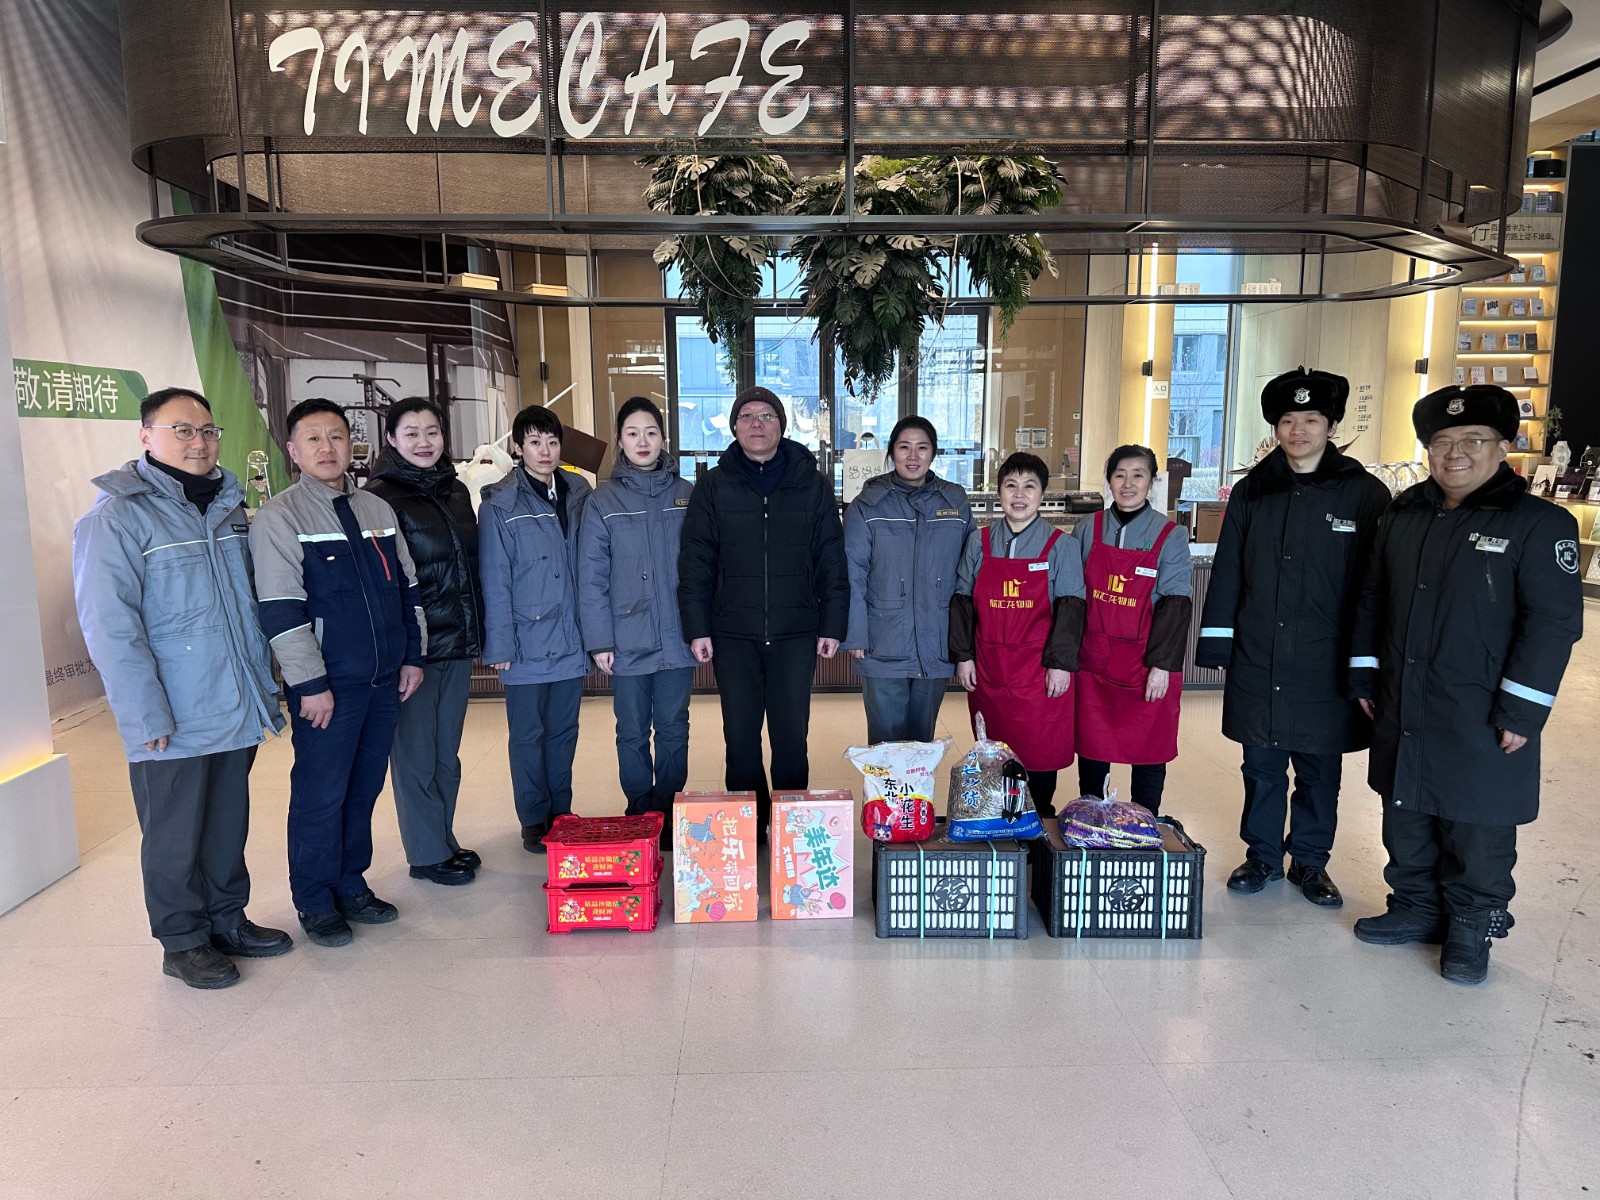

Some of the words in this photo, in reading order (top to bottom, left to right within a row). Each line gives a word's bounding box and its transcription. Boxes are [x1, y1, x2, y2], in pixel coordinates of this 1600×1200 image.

[13, 366, 119, 414] 敬请期待
[899, 782, 915, 831] 小花生
[720, 816, 746, 912] 把乐带回家
[803, 825, 840, 891] 美年达
